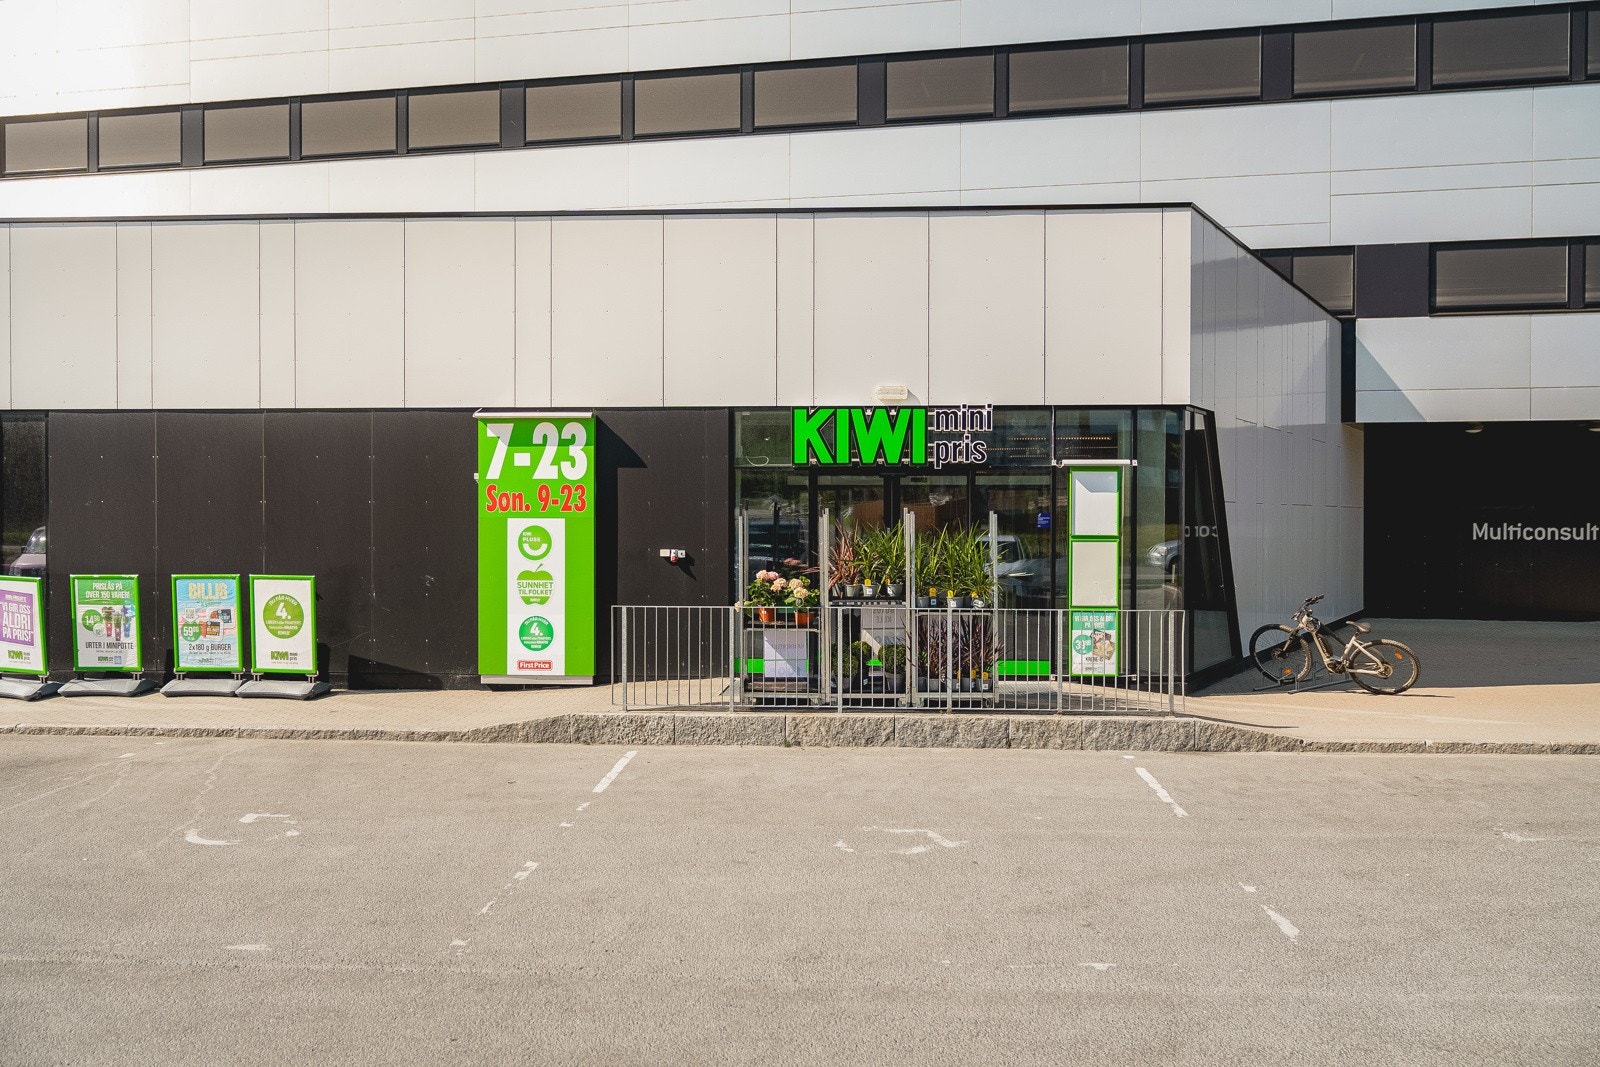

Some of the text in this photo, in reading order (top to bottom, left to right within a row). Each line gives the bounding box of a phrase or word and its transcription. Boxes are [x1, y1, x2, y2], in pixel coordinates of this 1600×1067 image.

[934, 403, 993, 432] mini
[792, 406, 928, 467] KIWI
[486, 422, 588, 480] 7-23
[934, 433, 987, 469] pris
[486, 484, 587, 513] Søn. 9-23
[1473, 522, 1600, 540] Multiconsult
[86, 590, 100, 598] OVER
[101, 591, 110, 599] 150
[92, 581, 114, 590] PRISLÅS
[188, 581, 228, 600] BILLIG
[20, 604, 31, 615] OSS
[275, 602, 292, 620] 4.
[3, 611, 31, 631] ALDRI
[210, 643, 231, 651] BURGER
[271, 651, 289, 660] KIWI
